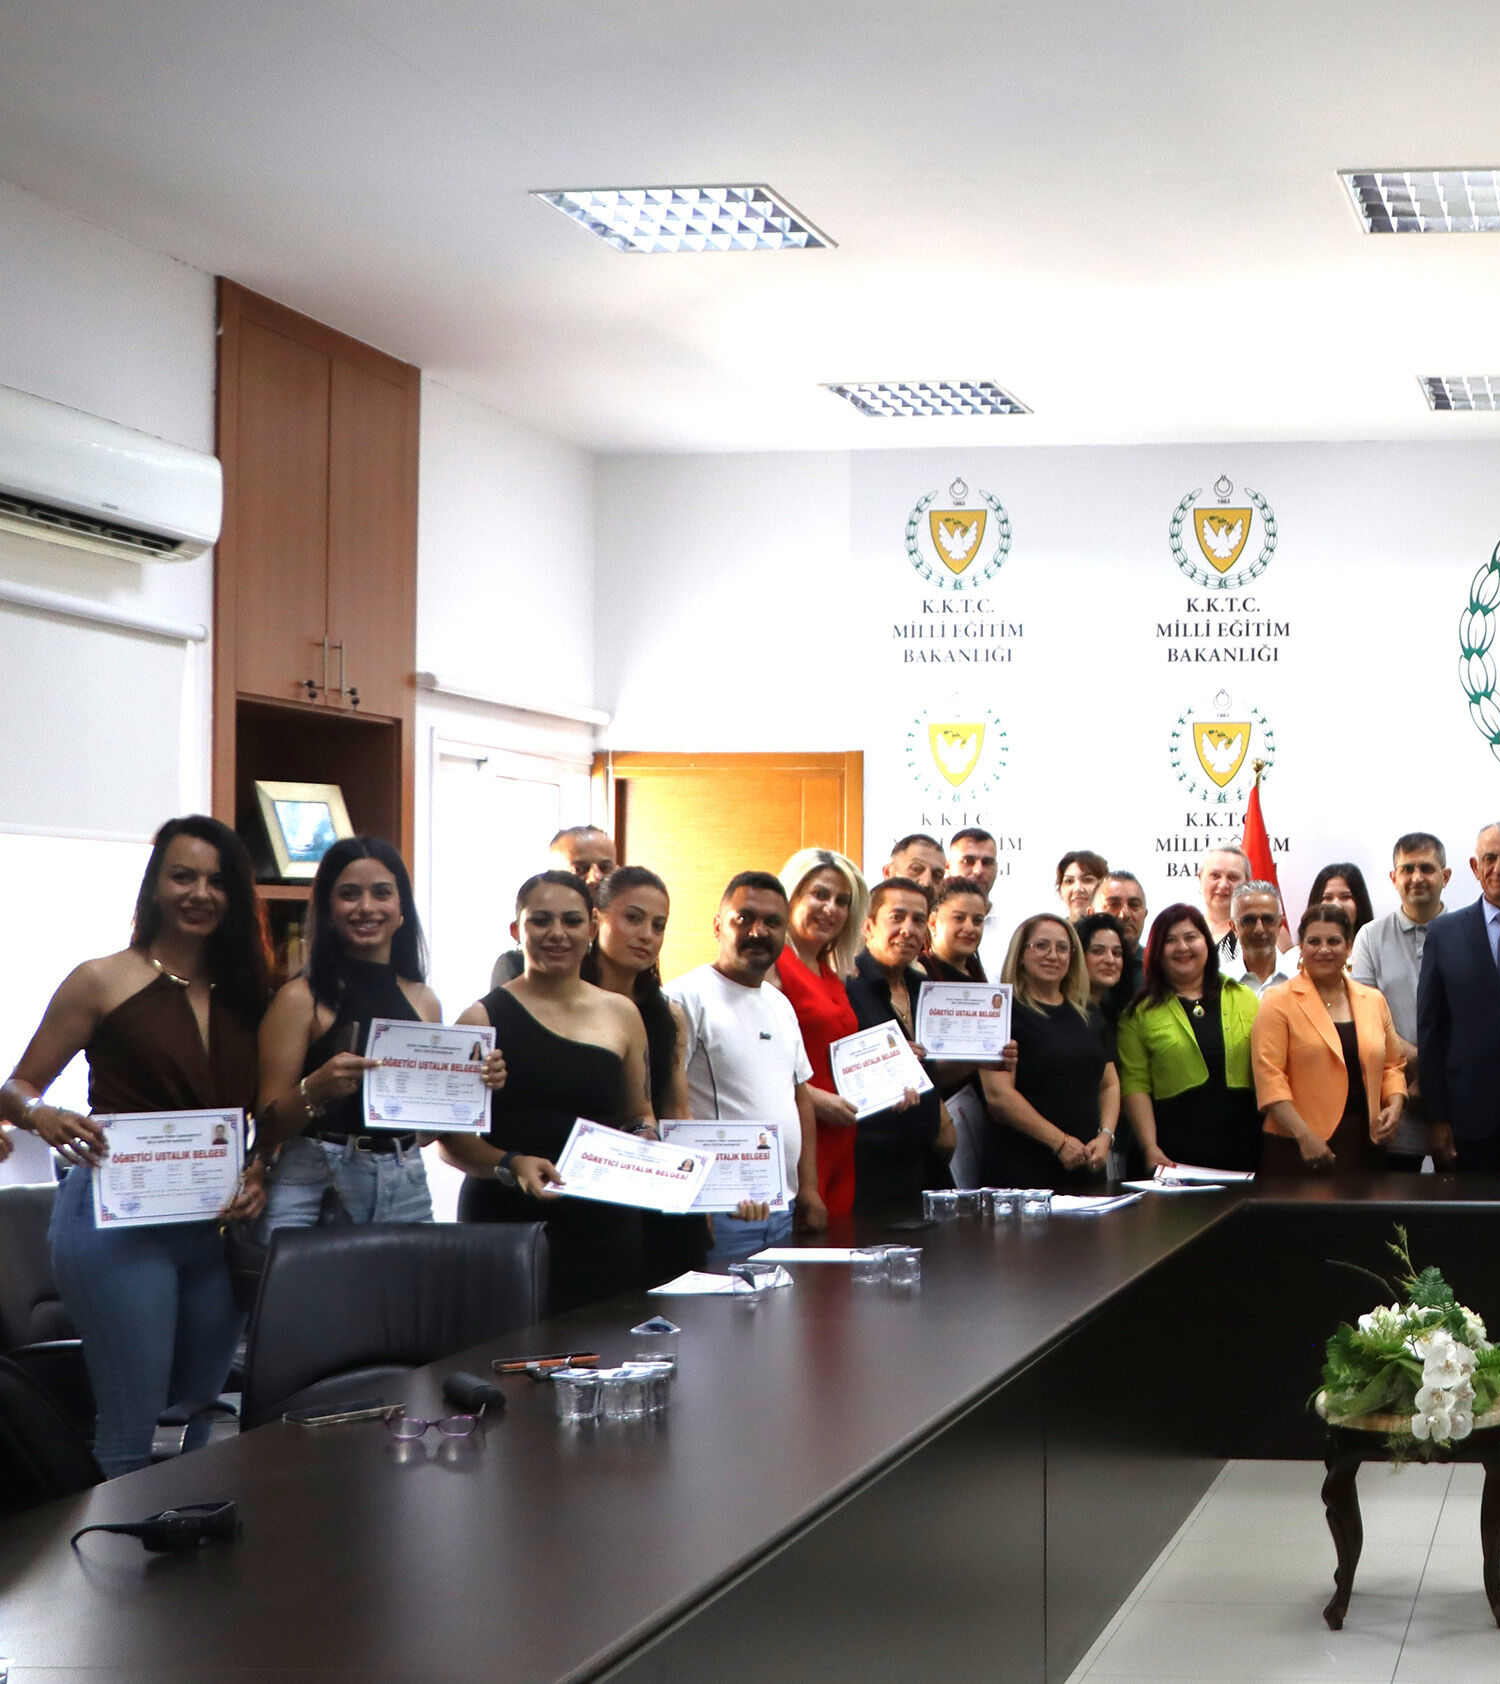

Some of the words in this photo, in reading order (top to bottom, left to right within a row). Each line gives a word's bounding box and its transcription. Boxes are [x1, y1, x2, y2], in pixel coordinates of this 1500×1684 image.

[922, 599, 995, 614] K.K.T.C.
[1186, 597, 1261, 613] K.K.T.C.
[892, 621, 946, 639] MİLLİ
[953, 620, 1024, 639] EĞİTİM
[1155, 619, 1210, 637] MİLLİ
[1217, 618, 1290, 637] EĞİTİM
[903, 645, 1012, 663] BAKANLIĞI
[1167, 643, 1279, 662] BAKANLIĞI
[1186, 812, 1248, 827] K.K.T.
[716, 1152, 740, 1161] TALIK
